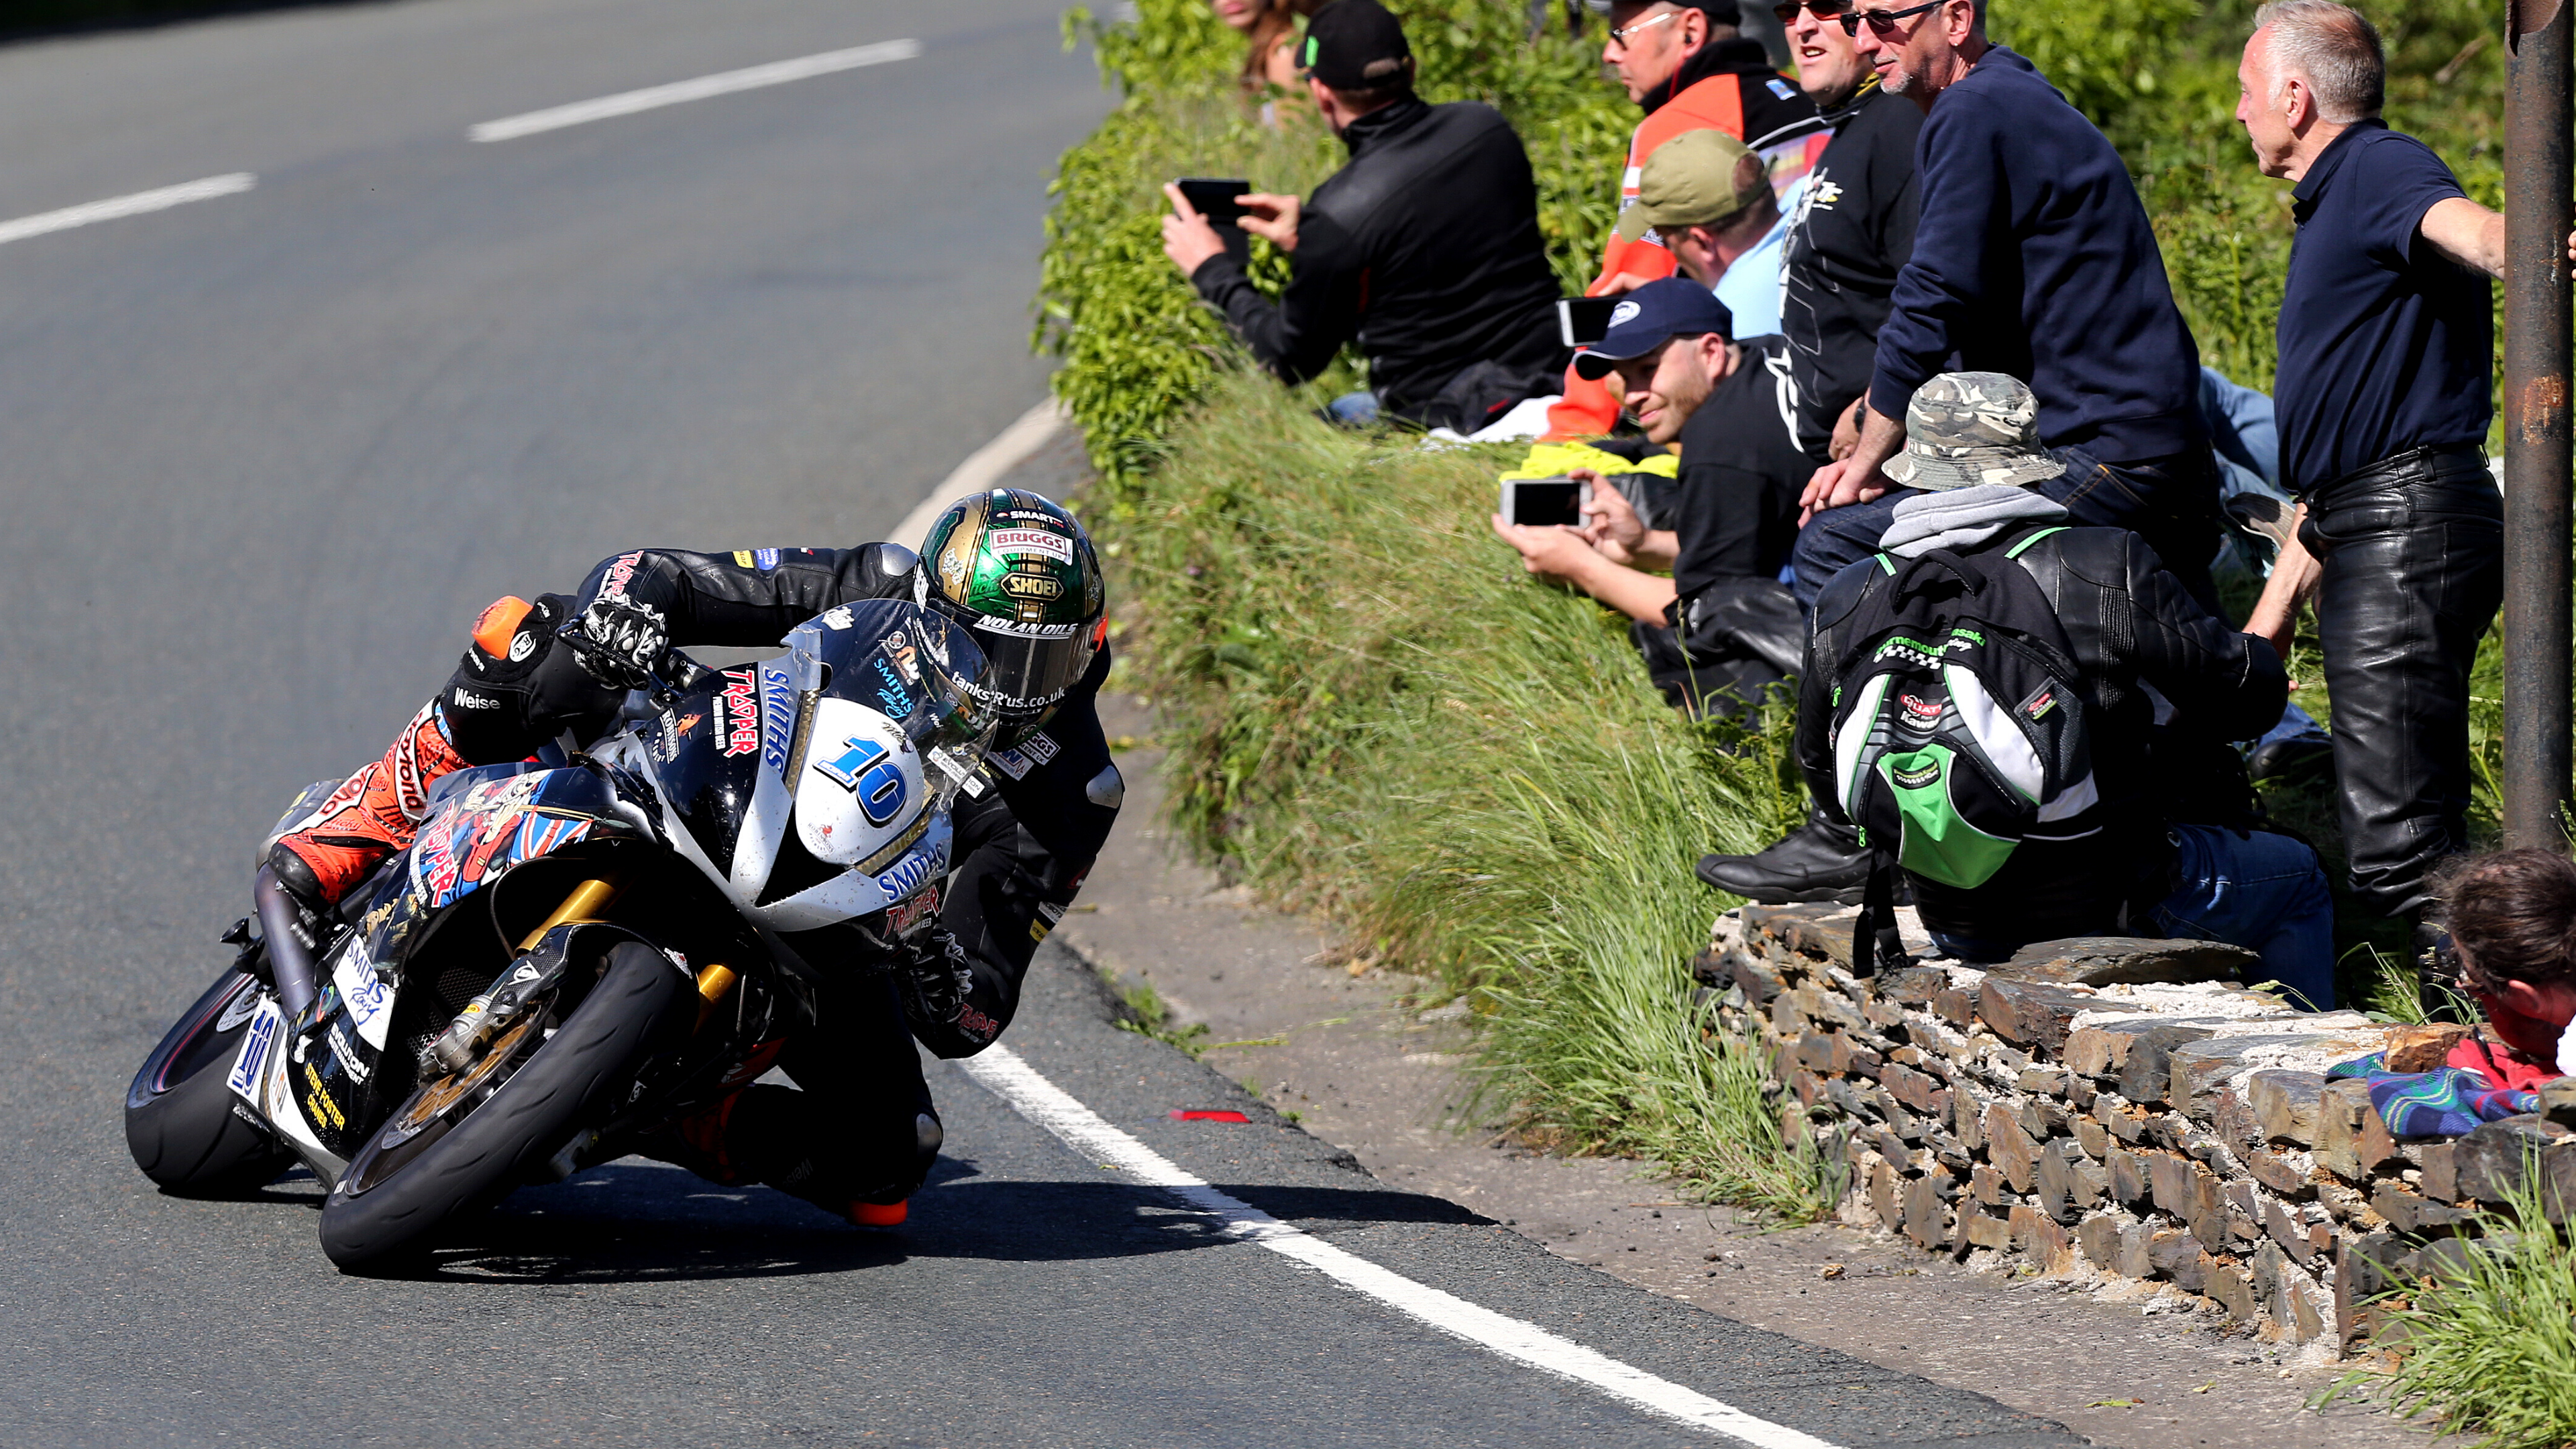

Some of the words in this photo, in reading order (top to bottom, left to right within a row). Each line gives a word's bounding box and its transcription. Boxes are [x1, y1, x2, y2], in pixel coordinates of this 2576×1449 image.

[1010, 511, 1063, 524] SMART
[997, 534, 1063, 549] BRIGGS
[997, 548, 1049, 557] EQUIPMENT
[1010, 577, 1057, 596] SHOEI
[979, 614, 1039, 634] NOLAN
[1040, 623, 1078, 635] OILS
[602, 649, 614, 659] RACE
[614, 655, 638, 671] SUPPORT
[454, 687, 500, 710] Weise
[874, 657, 914, 713] SMITHS
[720, 669, 759, 759] TROOPER
[763, 666, 790, 773] SMITHS
[661, 709, 678, 762] ROBINSONS
[813, 735, 908, 824] 10
[421, 798, 458, 908] TROOPER
[808, 823, 833, 853] ROBINSONS
[877, 843, 946, 903] SMITHS
[417, 884, 428, 905] BEER
[920, 917, 932, 930] BEER
[347, 938, 386, 1004] SMITHS
[305, 1062, 321, 1095] STEVE
[321, 1088, 345, 1131] FOSTER
[307, 1093, 327, 1128] CRANES
